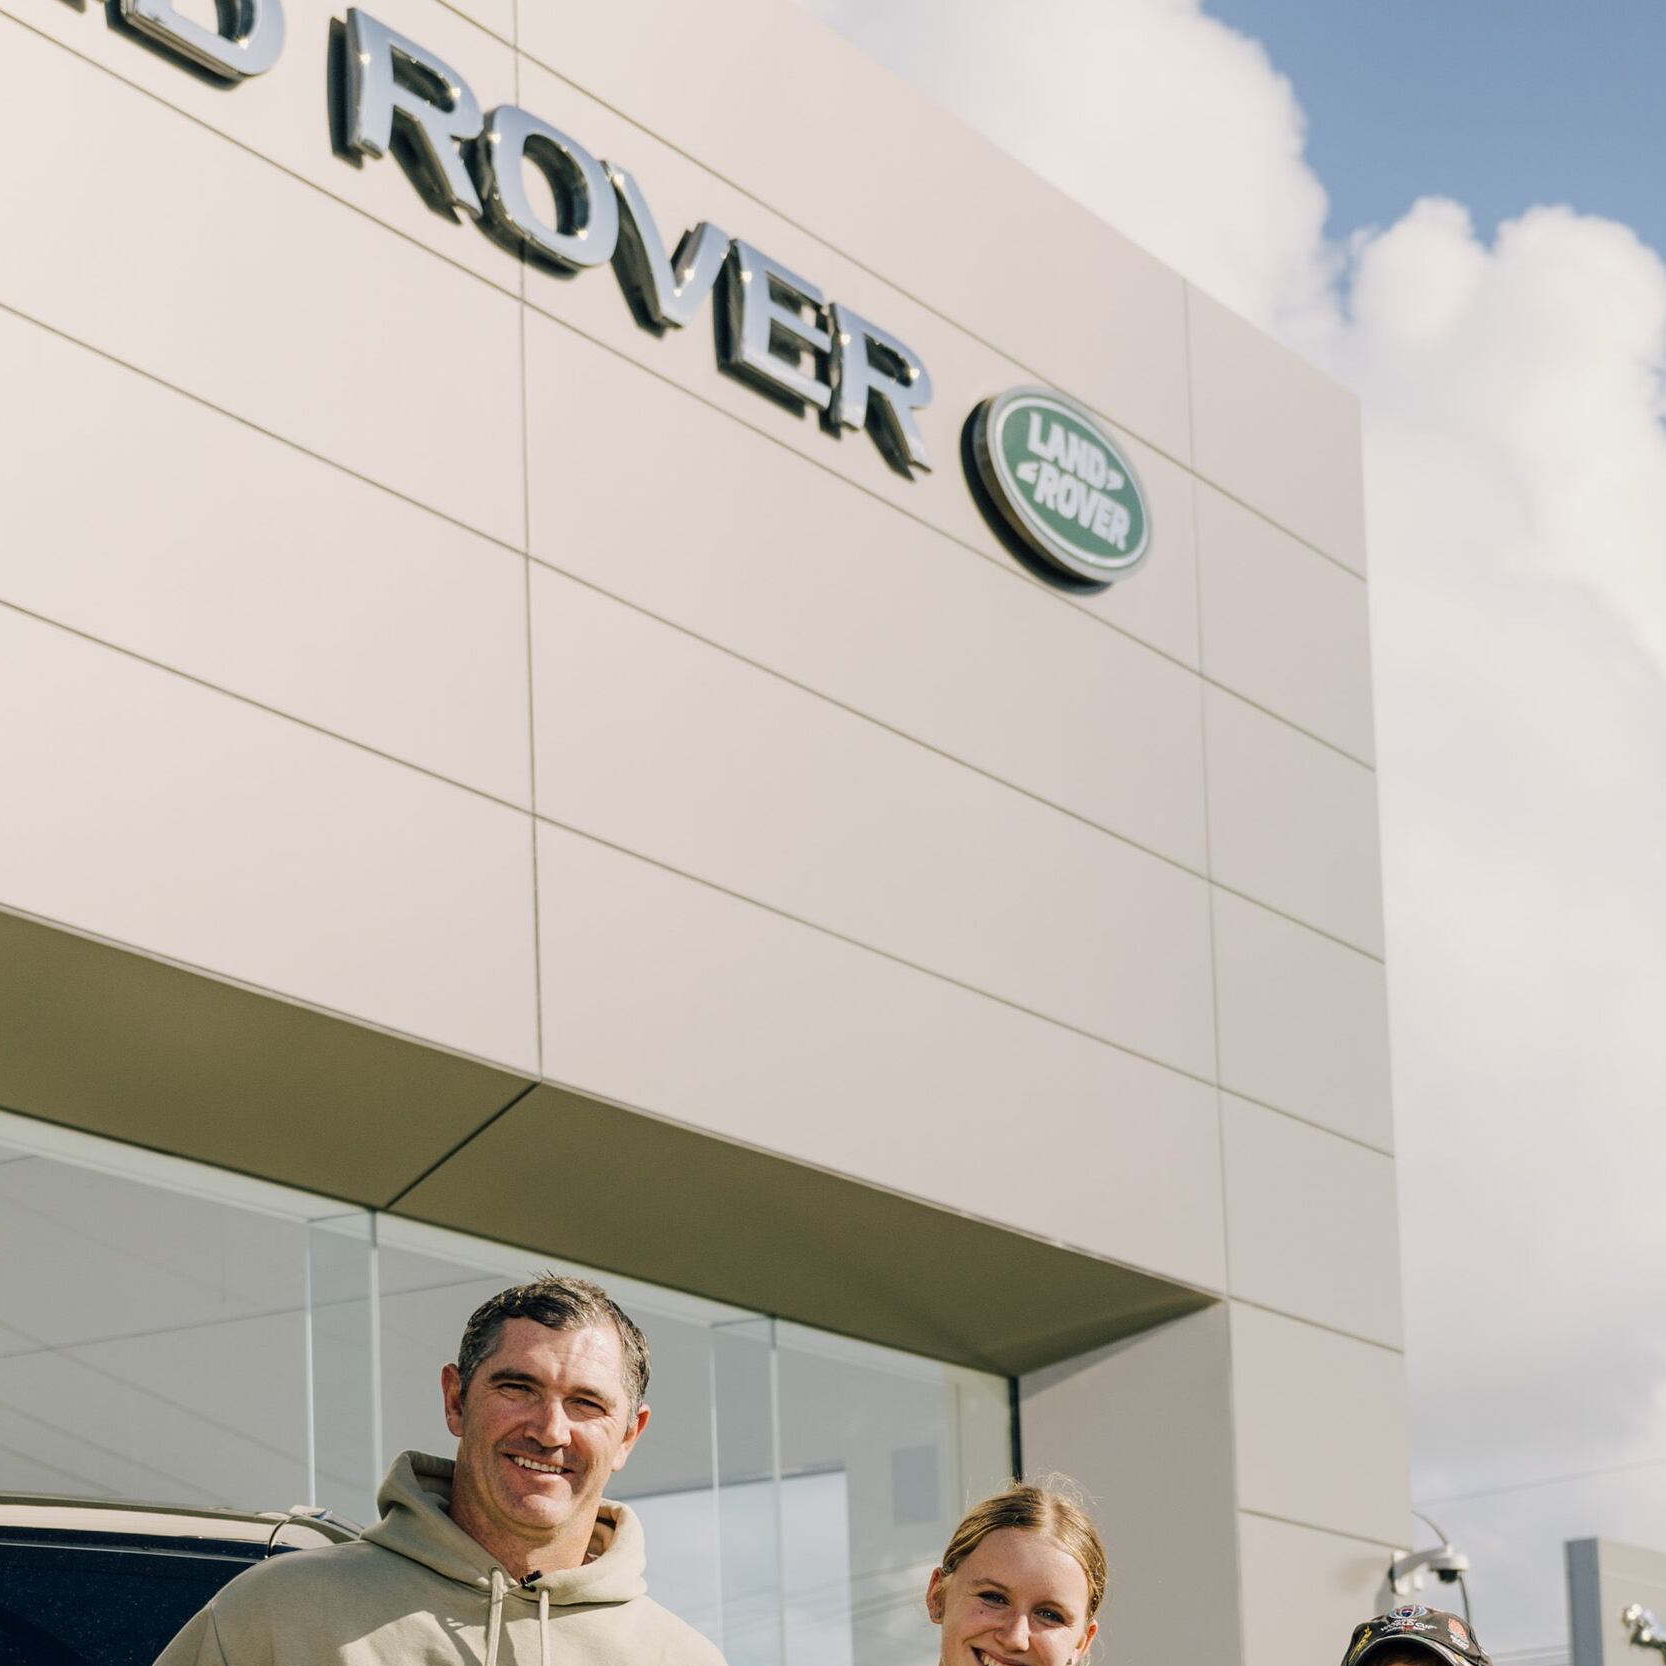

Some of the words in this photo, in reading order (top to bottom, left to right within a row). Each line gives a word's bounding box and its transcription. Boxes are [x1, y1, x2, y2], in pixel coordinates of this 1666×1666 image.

[337, 6, 933, 476] ROVER
[1027, 410, 1109, 491] LAND
[1033, 460, 1131, 552] ROVER
